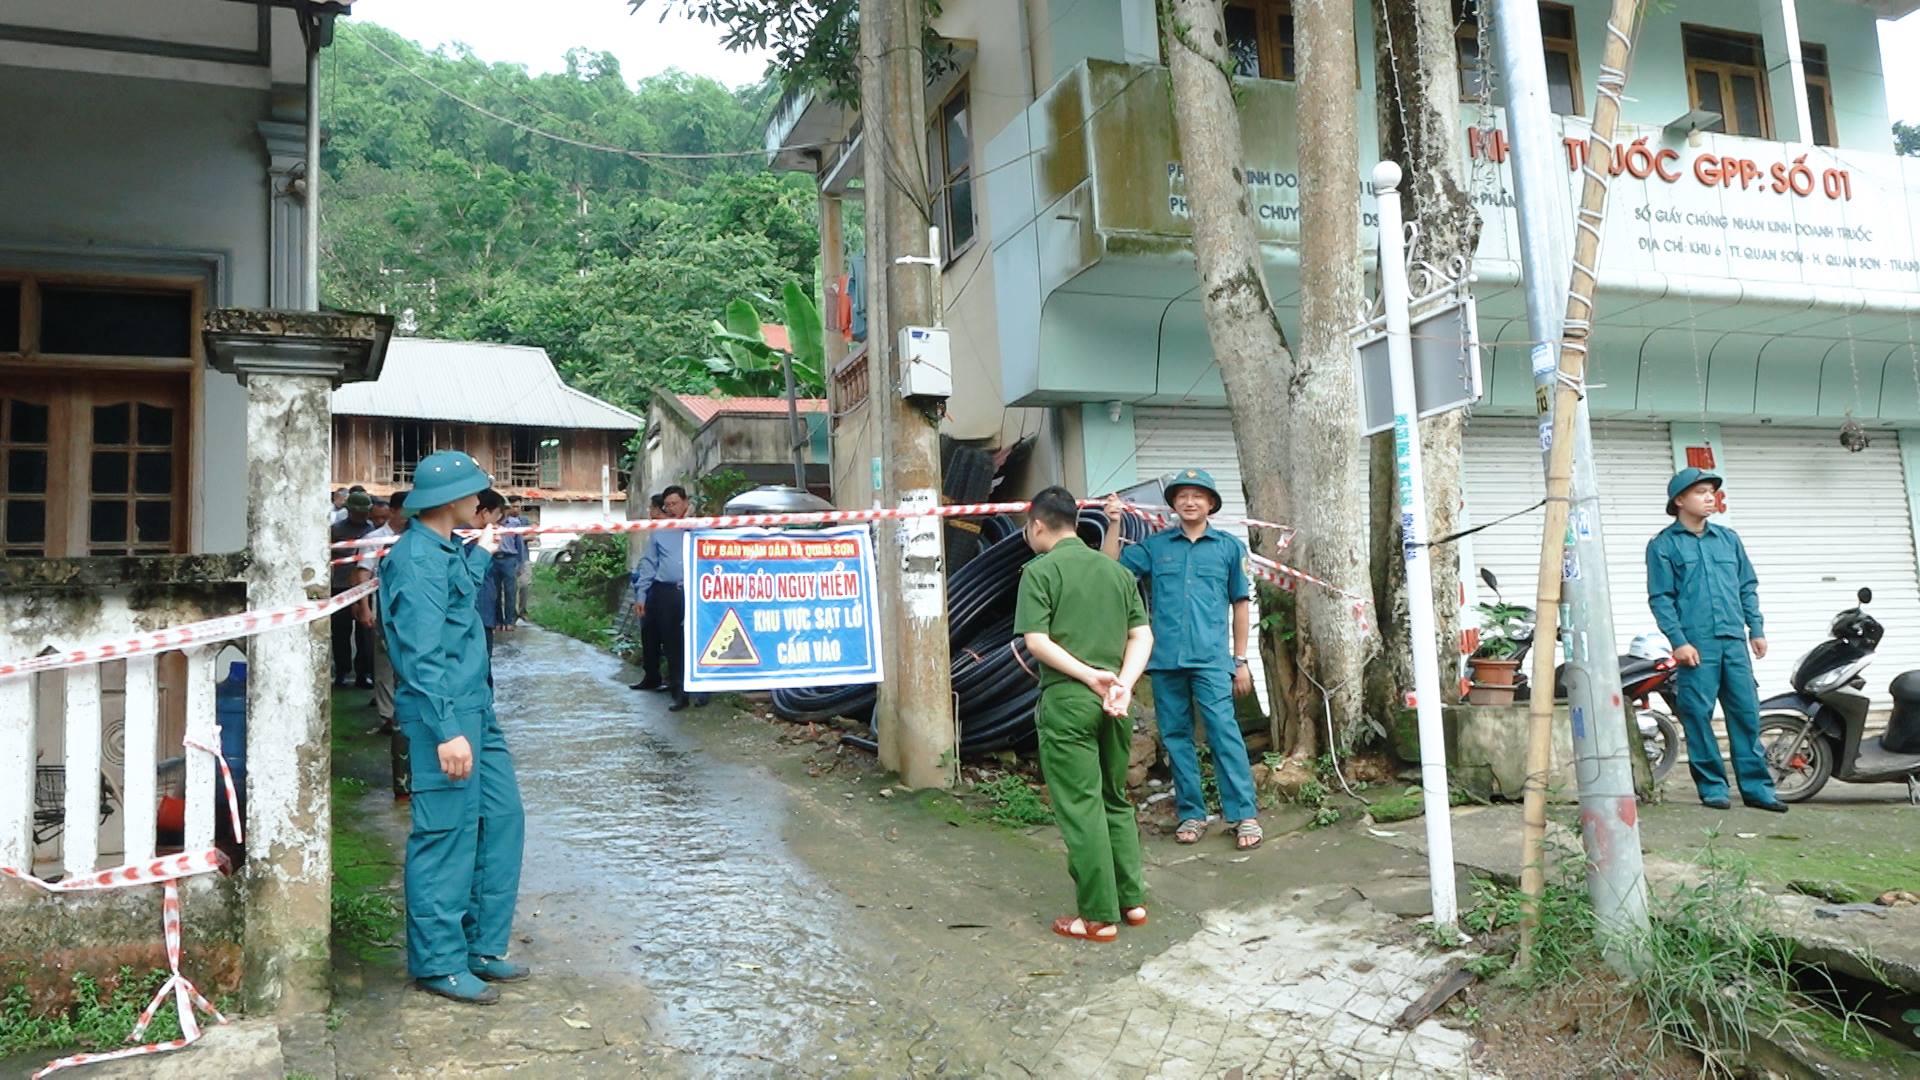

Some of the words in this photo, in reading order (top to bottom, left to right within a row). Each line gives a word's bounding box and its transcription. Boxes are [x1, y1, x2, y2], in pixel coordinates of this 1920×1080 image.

[1770, 153, 1815, 197] SỐ
[1823, 168, 1852, 201] 01
[719, 543, 742, 557] BAN
[805, 542, 832, 558] QUAN
[702, 566, 745, 600] CẢNH
[777, 574, 815, 599] NGUY
[820, 563, 858, 598] HIỂM
[753, 609, 780, 632] KHU
[814, 607, 841, 634] SẠT
[777, 632, 810, 664] CẤM
[812, 636, 841, 662] VÀO
